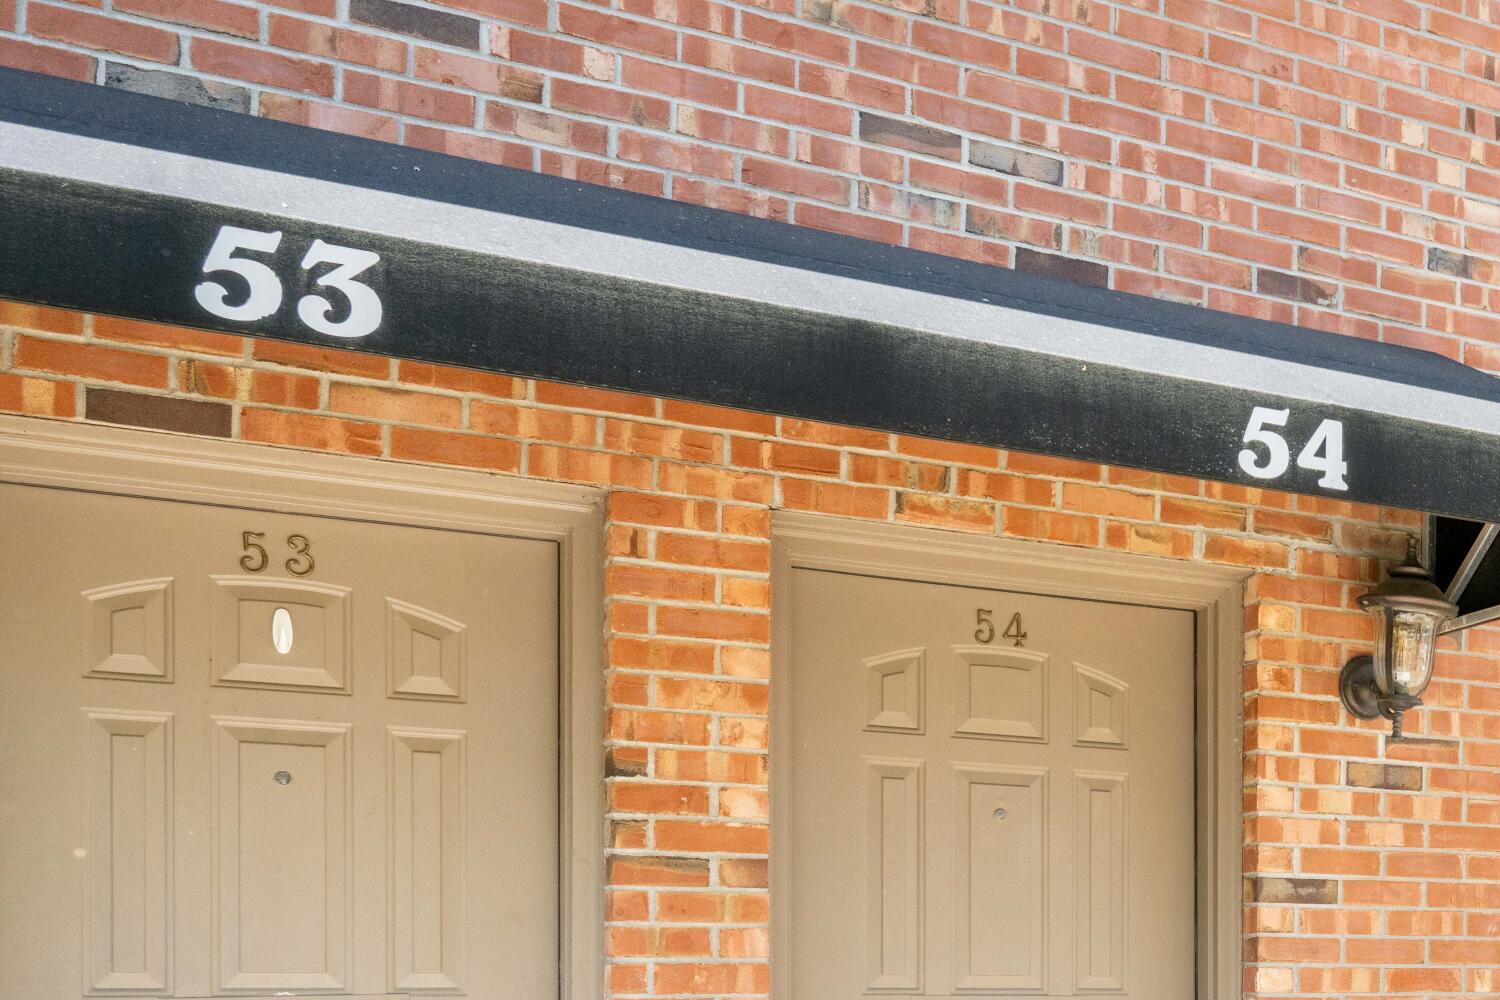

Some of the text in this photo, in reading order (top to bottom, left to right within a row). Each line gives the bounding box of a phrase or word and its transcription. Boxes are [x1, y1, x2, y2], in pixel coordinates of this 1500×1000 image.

[194, 225, 383, 338] 53
[1238, 406, 1349, 491] 54
[240, 531, 315, 577] 53
[974, 608, 1027, 648] 54
